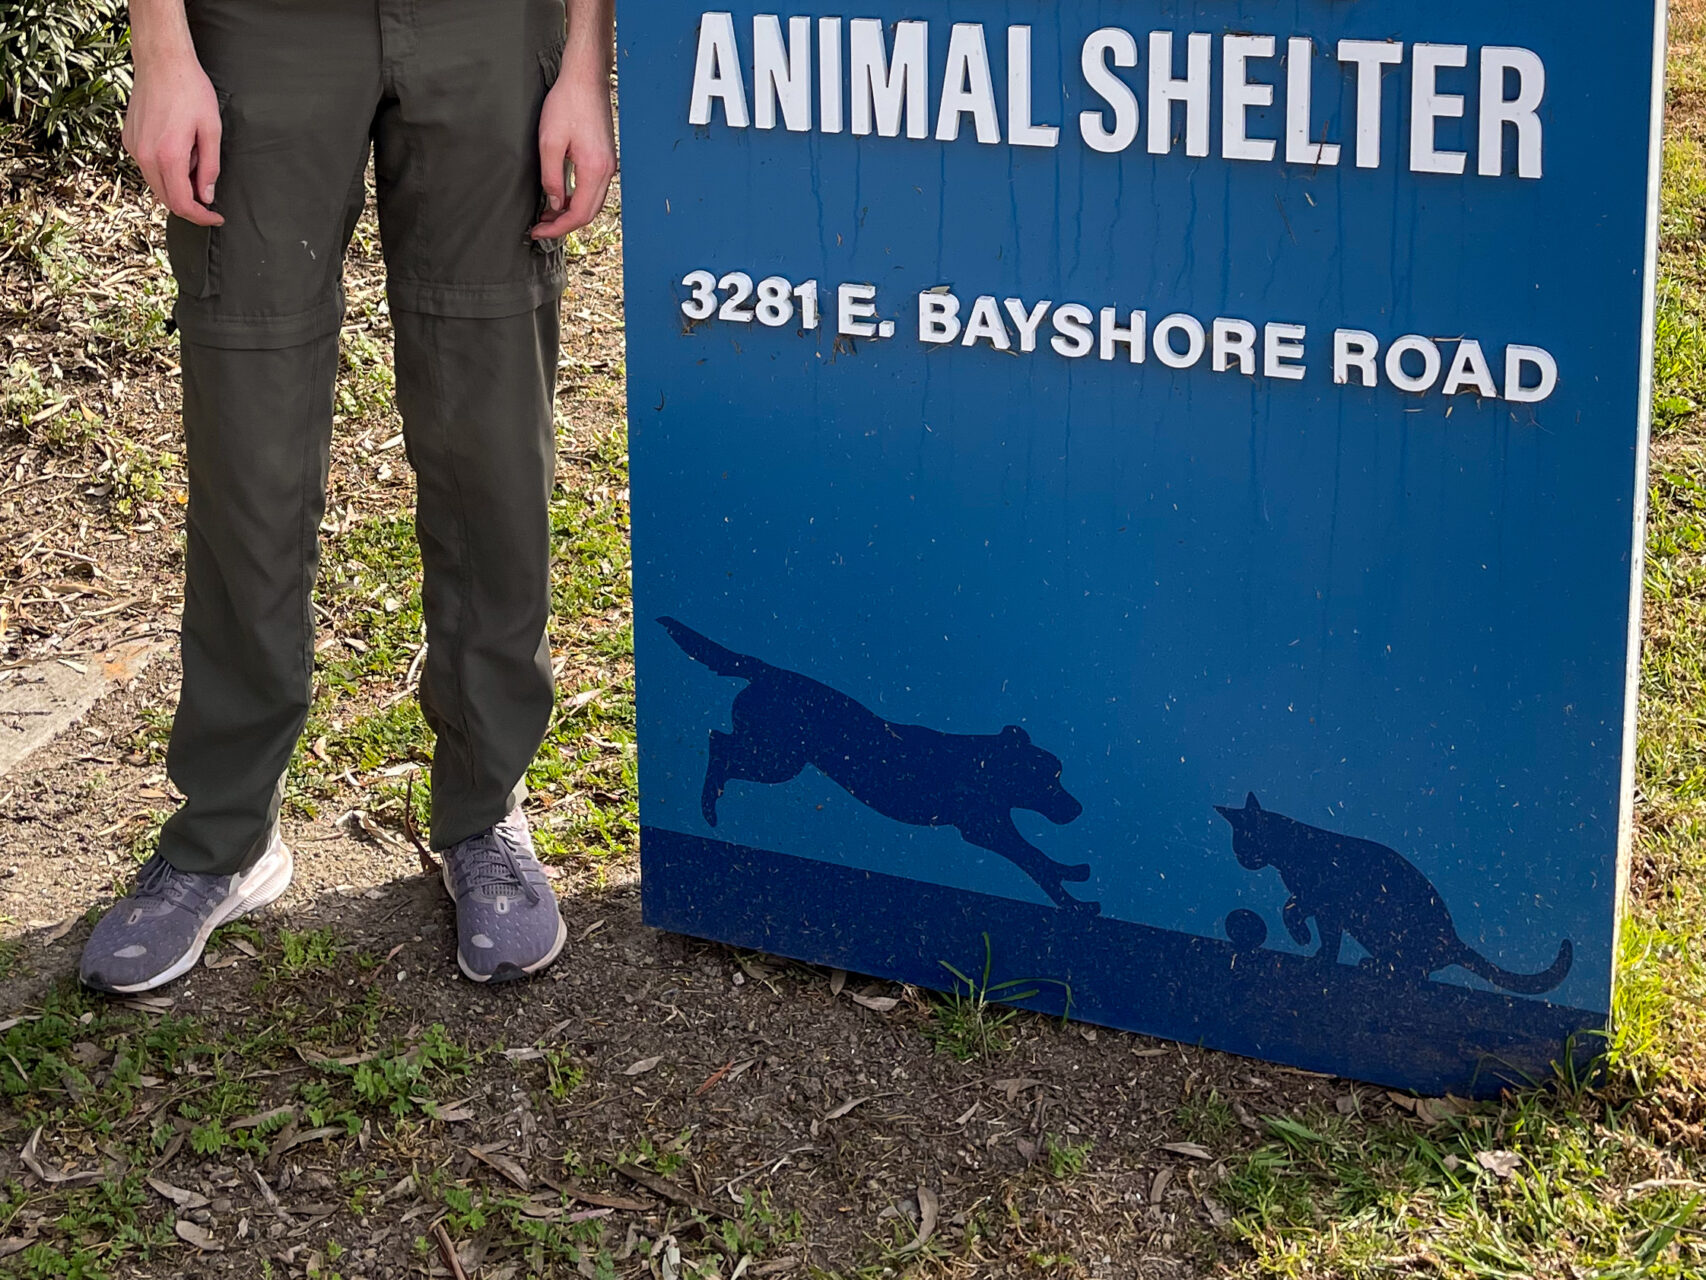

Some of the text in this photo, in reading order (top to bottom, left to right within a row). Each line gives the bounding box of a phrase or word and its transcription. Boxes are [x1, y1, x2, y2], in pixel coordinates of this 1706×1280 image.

[687, 11, 1546, 180] ANIMAL SHELTER
[680, 269, 1559, 405] 3281 E. BAYSHORE ROAD
